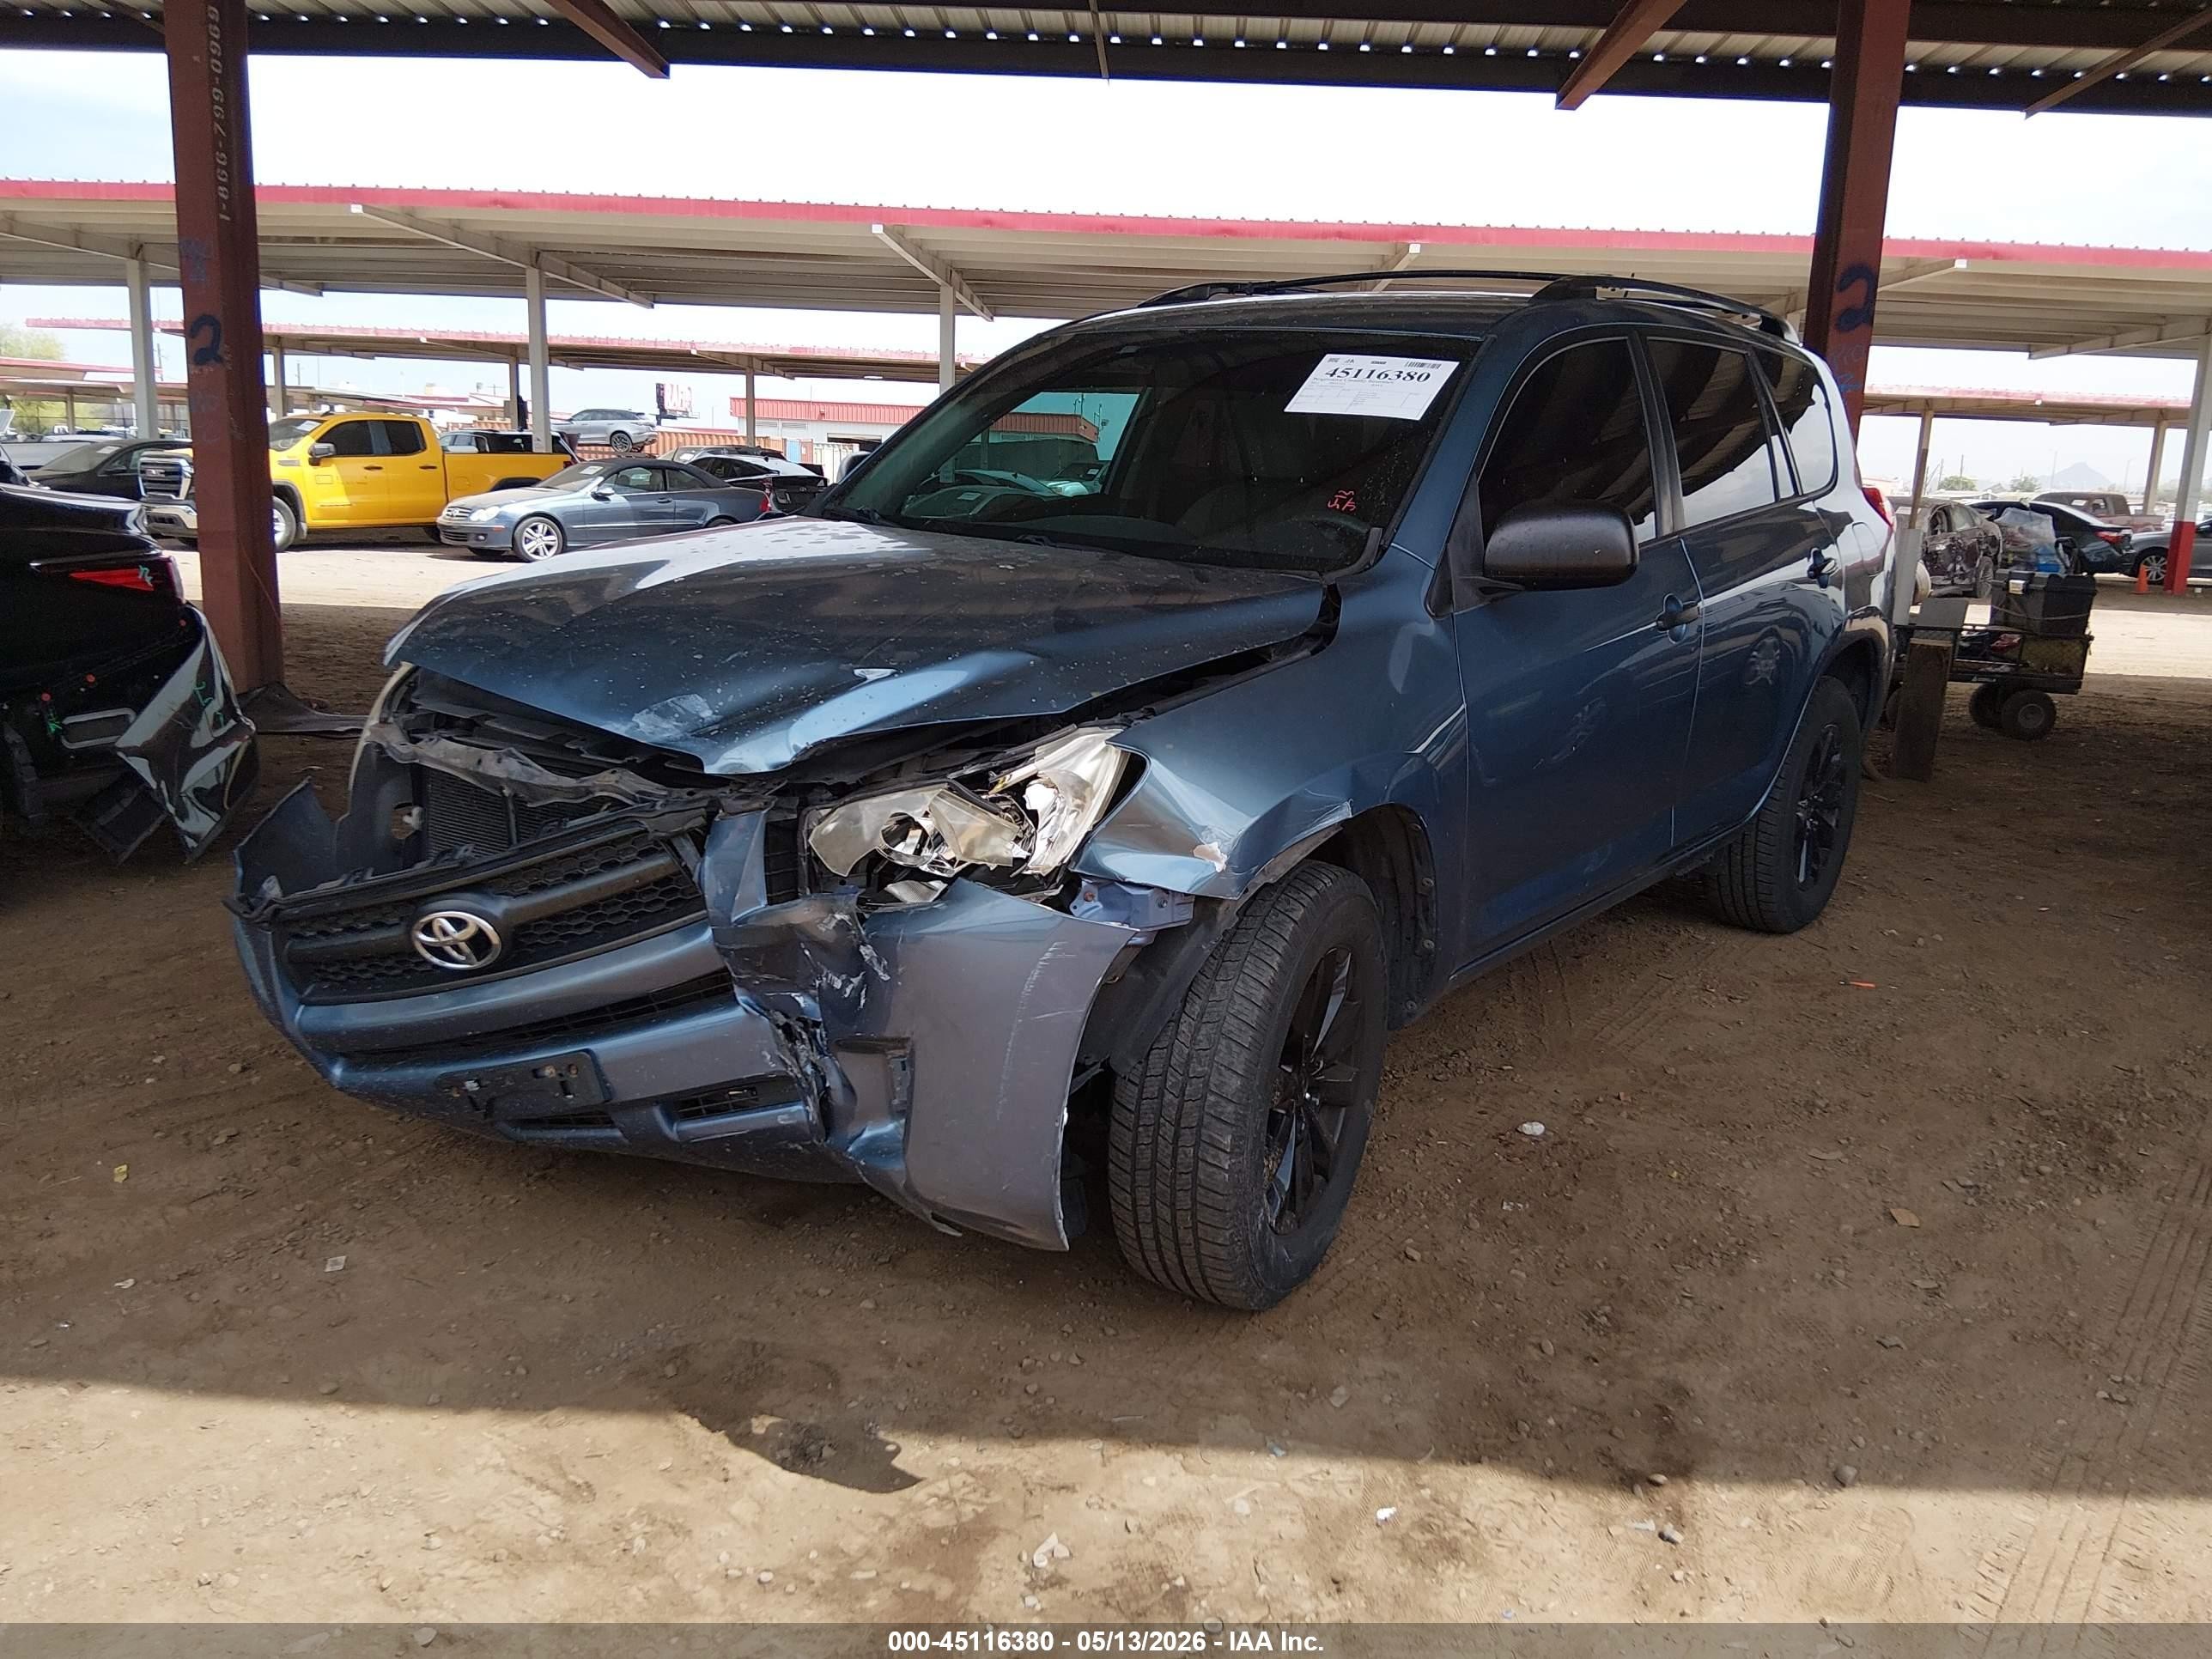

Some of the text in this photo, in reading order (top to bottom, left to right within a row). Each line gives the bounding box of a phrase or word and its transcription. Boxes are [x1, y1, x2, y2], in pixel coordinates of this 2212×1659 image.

[208, 5, 231, 222] 1-866-799-0969
[1836, 263, 1876, 332] 2
[189, 313, 223, 367] 2
[1325, 367, 1431, 383] 45116380
